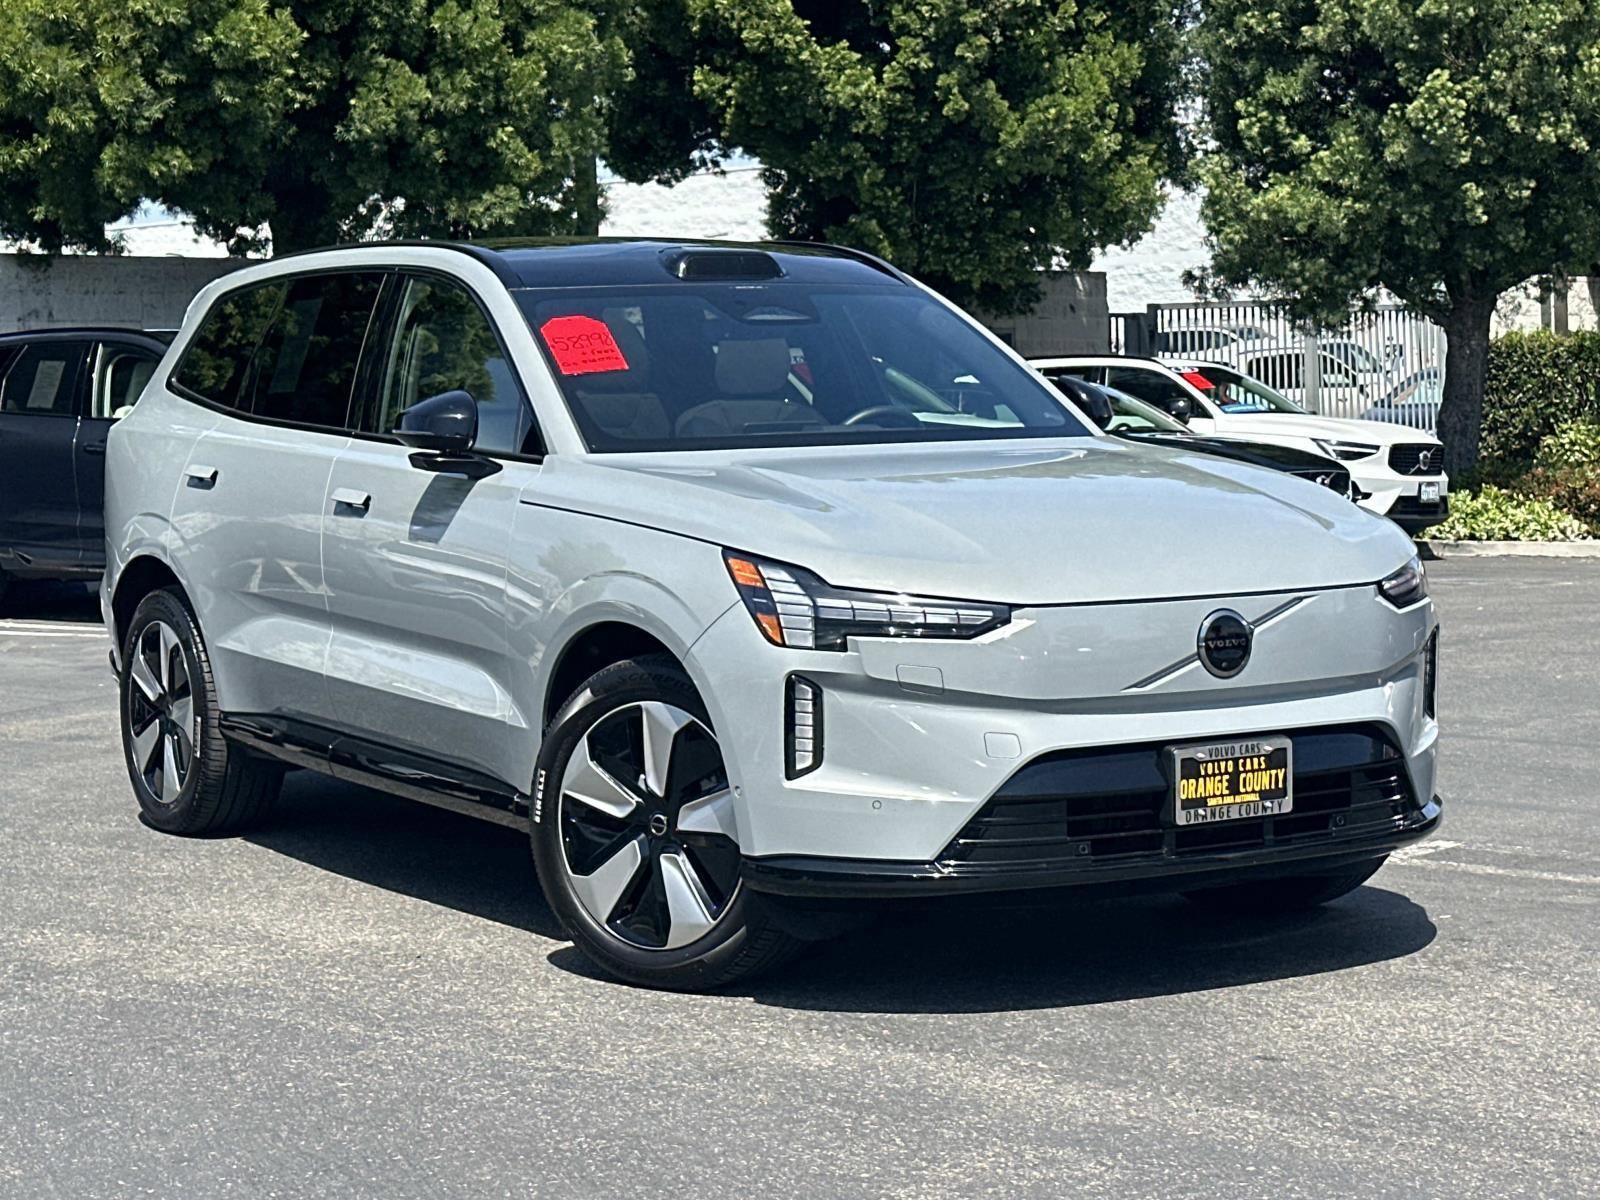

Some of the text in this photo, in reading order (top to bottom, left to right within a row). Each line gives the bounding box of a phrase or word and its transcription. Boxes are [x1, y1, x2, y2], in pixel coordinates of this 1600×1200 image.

[1207, 638, 1247, 649] VOLVO
[1208, 742, 1261, 758] VOLVO CARS
[1200, 756, 1266, 775] VOLVO CARS
[1180, 774, 1230, 800] ORANGE
[1239, 767, 1285, 793] COUNTY
[1185, 801, 1283, 824] ORANGE COUNTY
